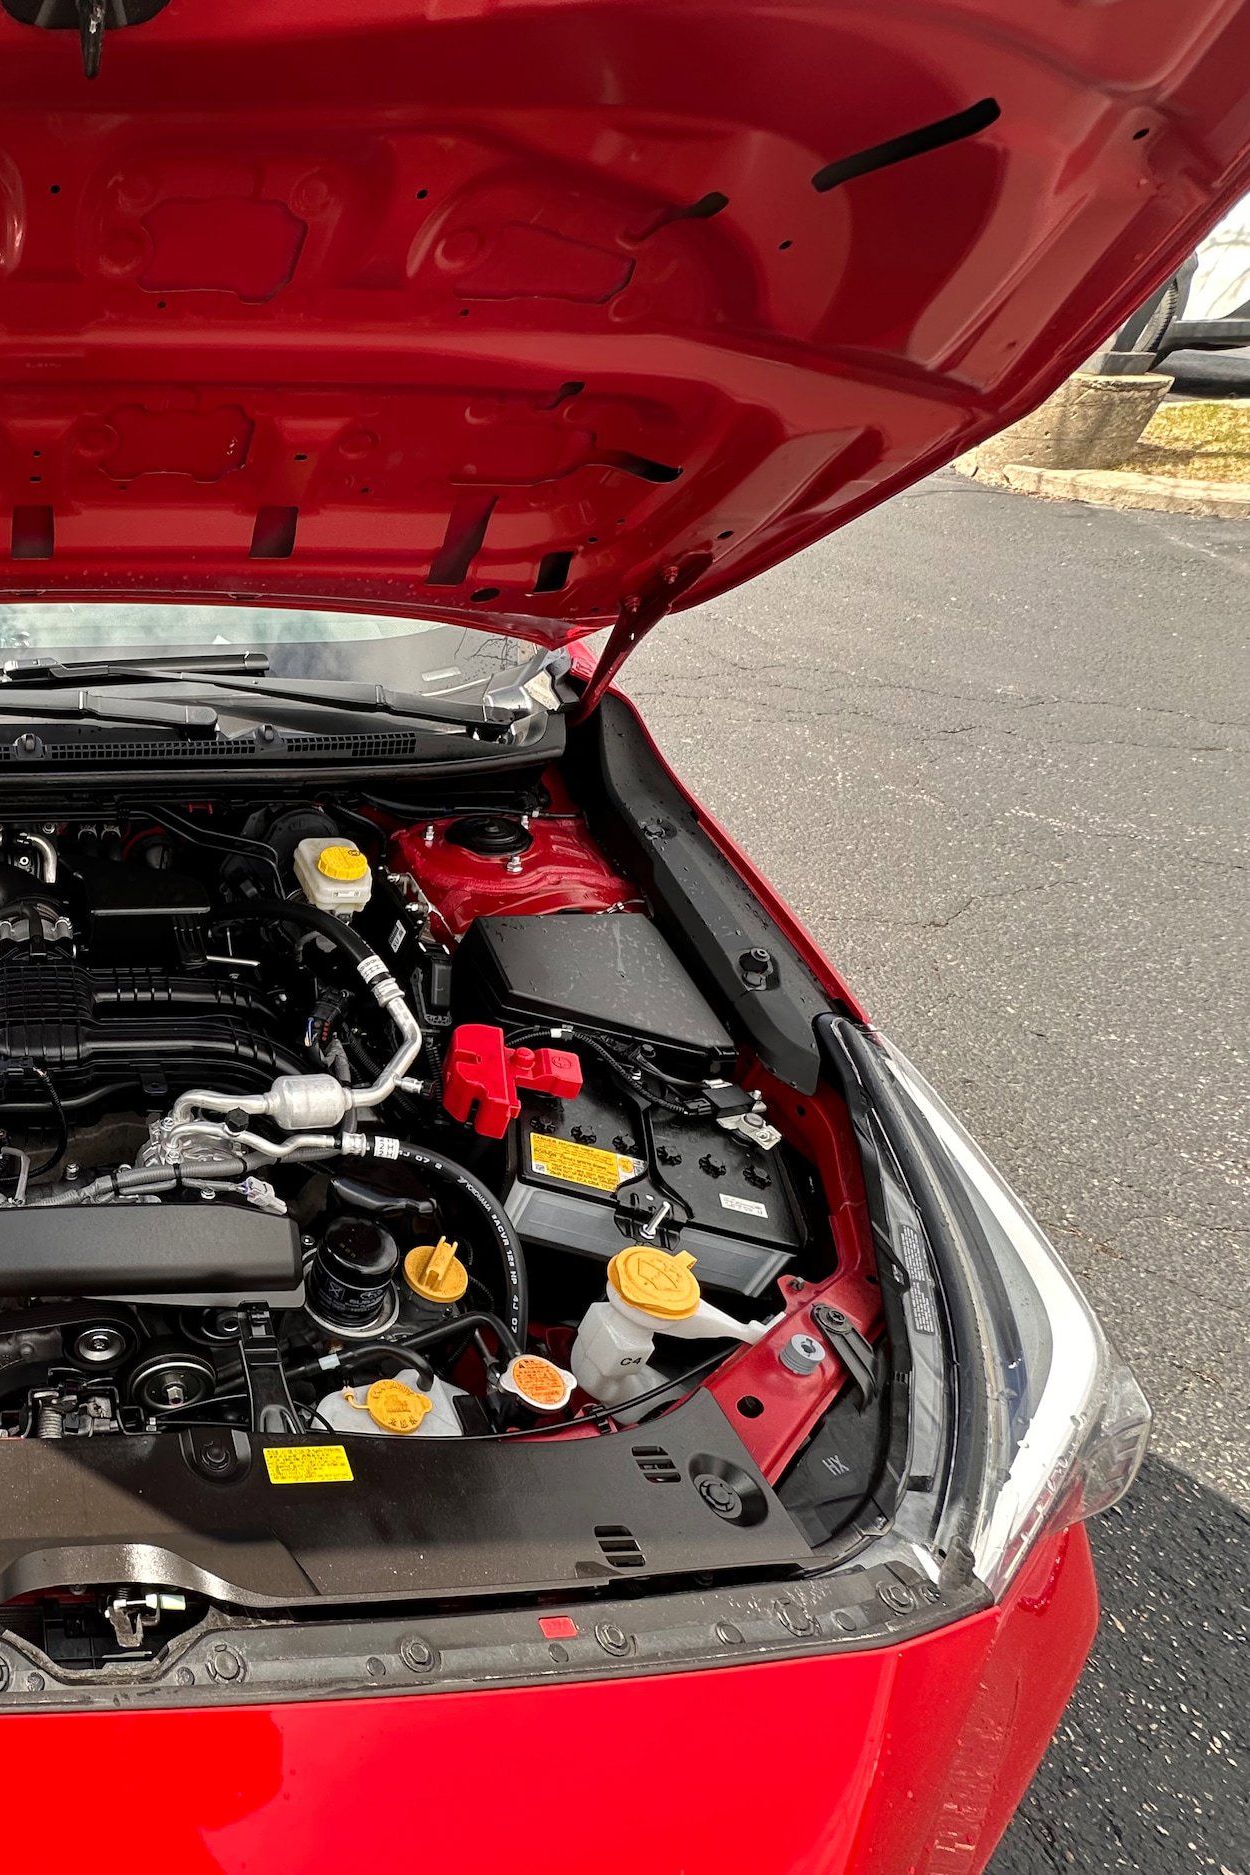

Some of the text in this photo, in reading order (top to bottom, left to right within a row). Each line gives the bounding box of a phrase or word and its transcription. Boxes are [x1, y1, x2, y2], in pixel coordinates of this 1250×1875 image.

[465, 1183, 491, 1212] YOKOHAMA
[510, 1270, 518, 1285] HP
[512, 1294, 519, 1310] 4J
[511, 1319, 519, 1334] 07
[620, 1357, 642, 1366] C4
[821, 1455, 850, 1475] HX
